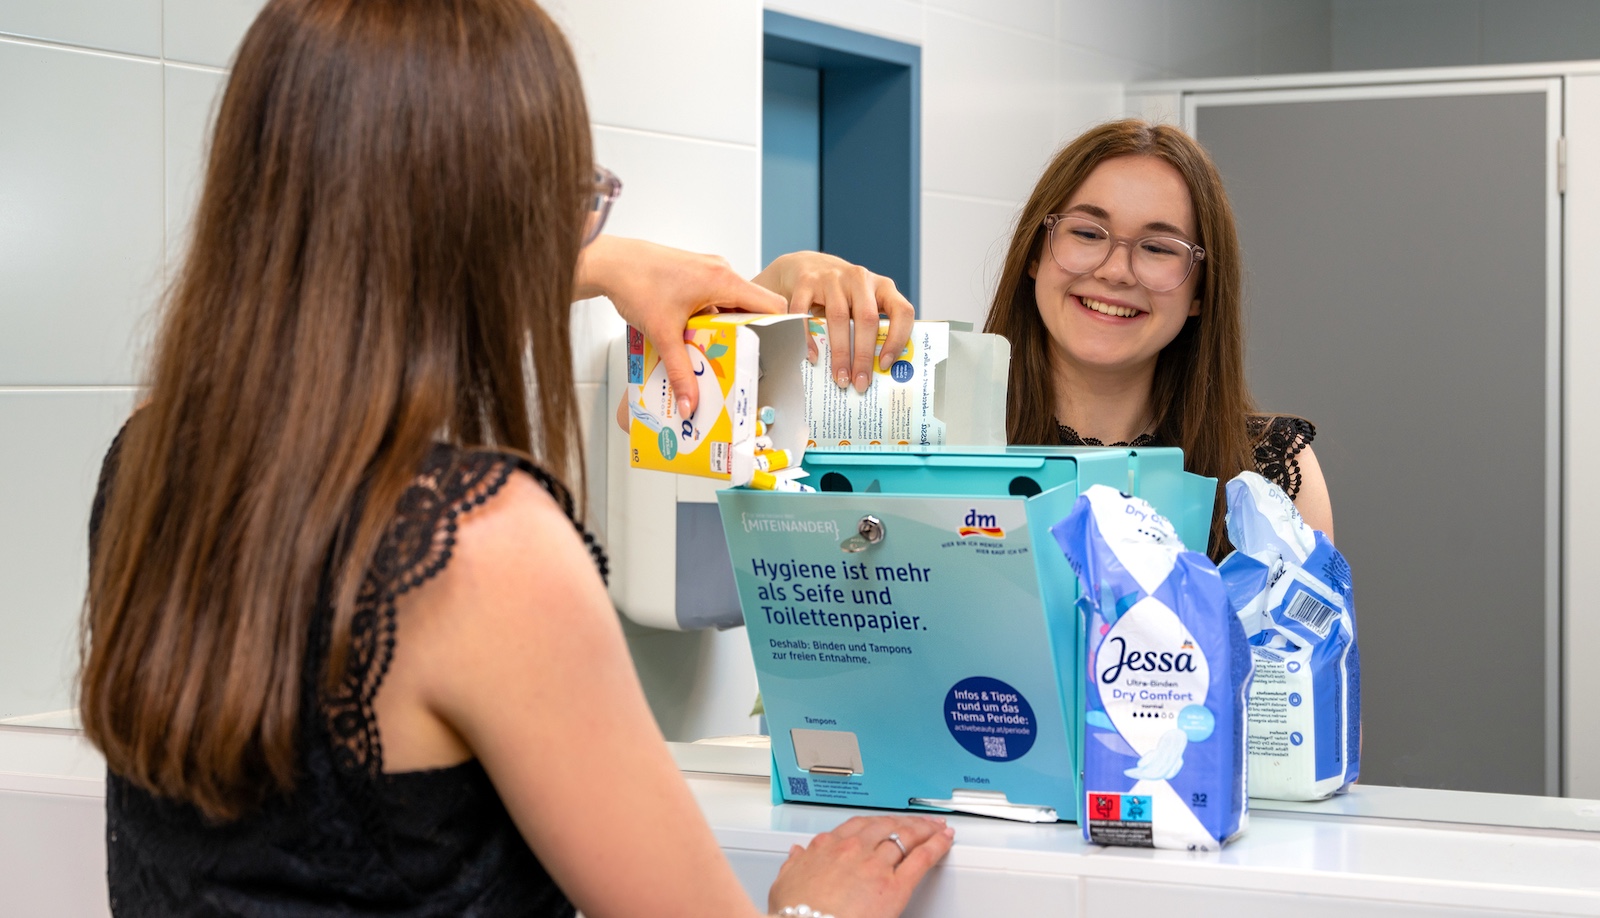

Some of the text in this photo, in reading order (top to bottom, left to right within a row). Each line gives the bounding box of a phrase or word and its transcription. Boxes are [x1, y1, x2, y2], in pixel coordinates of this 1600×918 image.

[965, 509, 996, 527] dm
[1125, 504, 1148, 522] Dry
[752, 559, 931, 582] Hygiene ist mehr
[758, 582, 892, 605] als Seife und
[761, 606, 927, 632] Toilettenpapier.
[769, 639, 912, 655] Deshalb: Binden und Tampons
[772, 651, 871, 664] zur freien Entnahme.
[1102, 637, 1197, 684] Jessa
[1126, 679, 1178, 687] Ultra-Binden
[954, 690, 1018, 703] Infos & Tipps
[1113, 689, 1193, 702] Dry Comfort
[957, 702, 1019, 713] rund um das
[805, 716, 837, 726] Tampons
[951, 711, 1029, 725] Thema Periode:
[954, 724, 1030, 734] activebeauty.at/periode
[963, 775, 990, 784] Binden
[1192, 793, 1208, 803] 32
